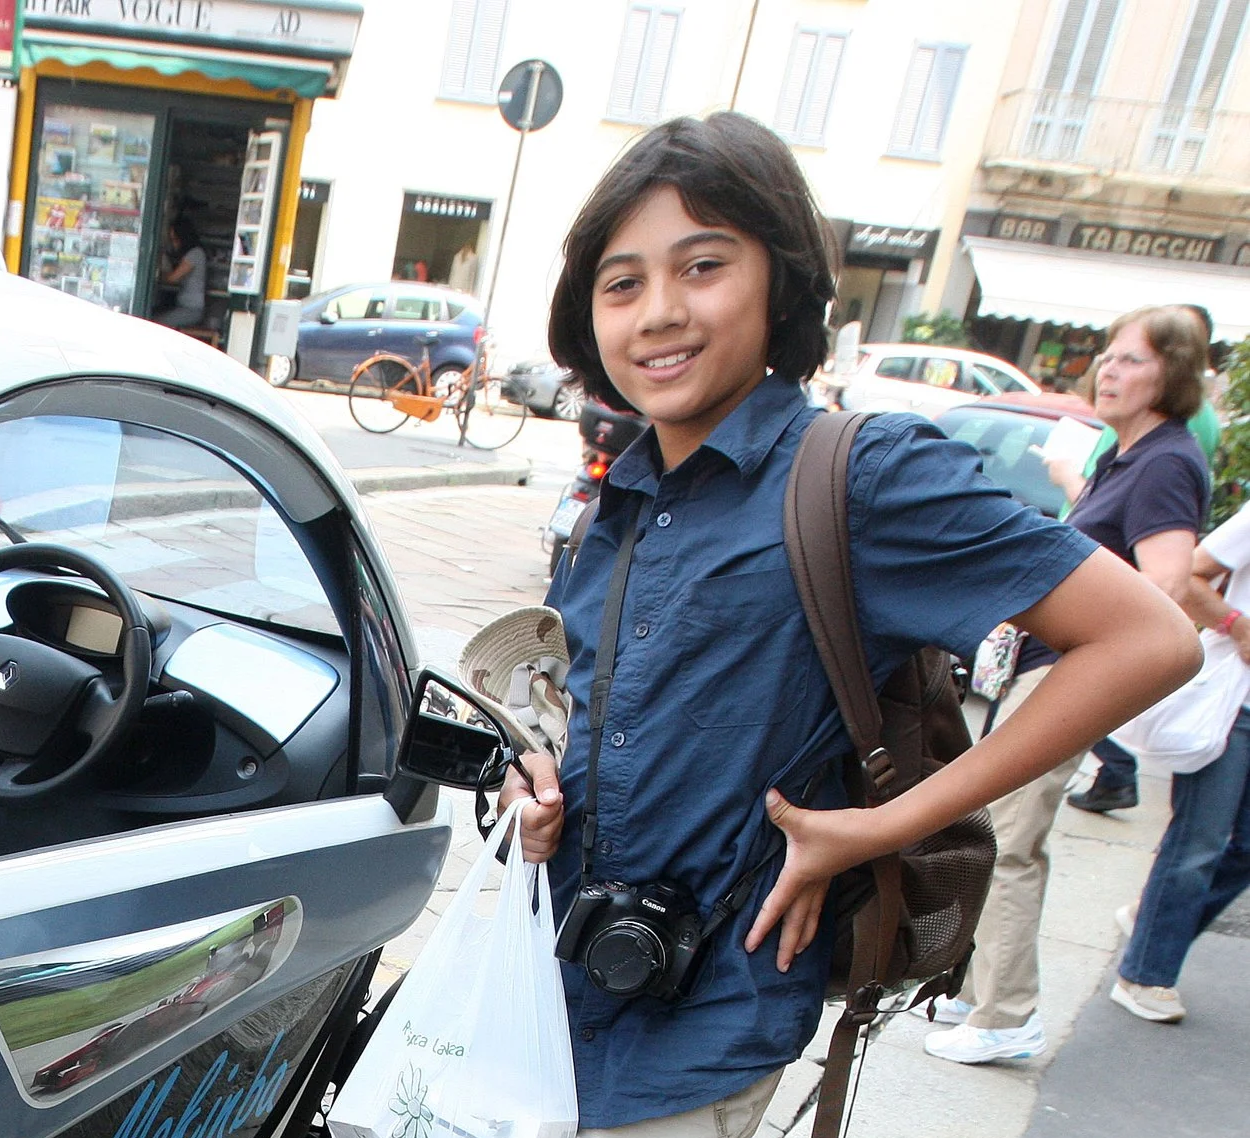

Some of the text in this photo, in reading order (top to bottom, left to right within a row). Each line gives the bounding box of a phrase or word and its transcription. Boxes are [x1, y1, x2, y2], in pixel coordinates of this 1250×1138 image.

[118, 0, 212, 32] VOGUE
[271, 9, 303, 35] AD
[1000, 218, 1046, 241] BAR
[1080, 226, 1215, 262] TABACCHI
[641, 898, 666, 913] Canon
